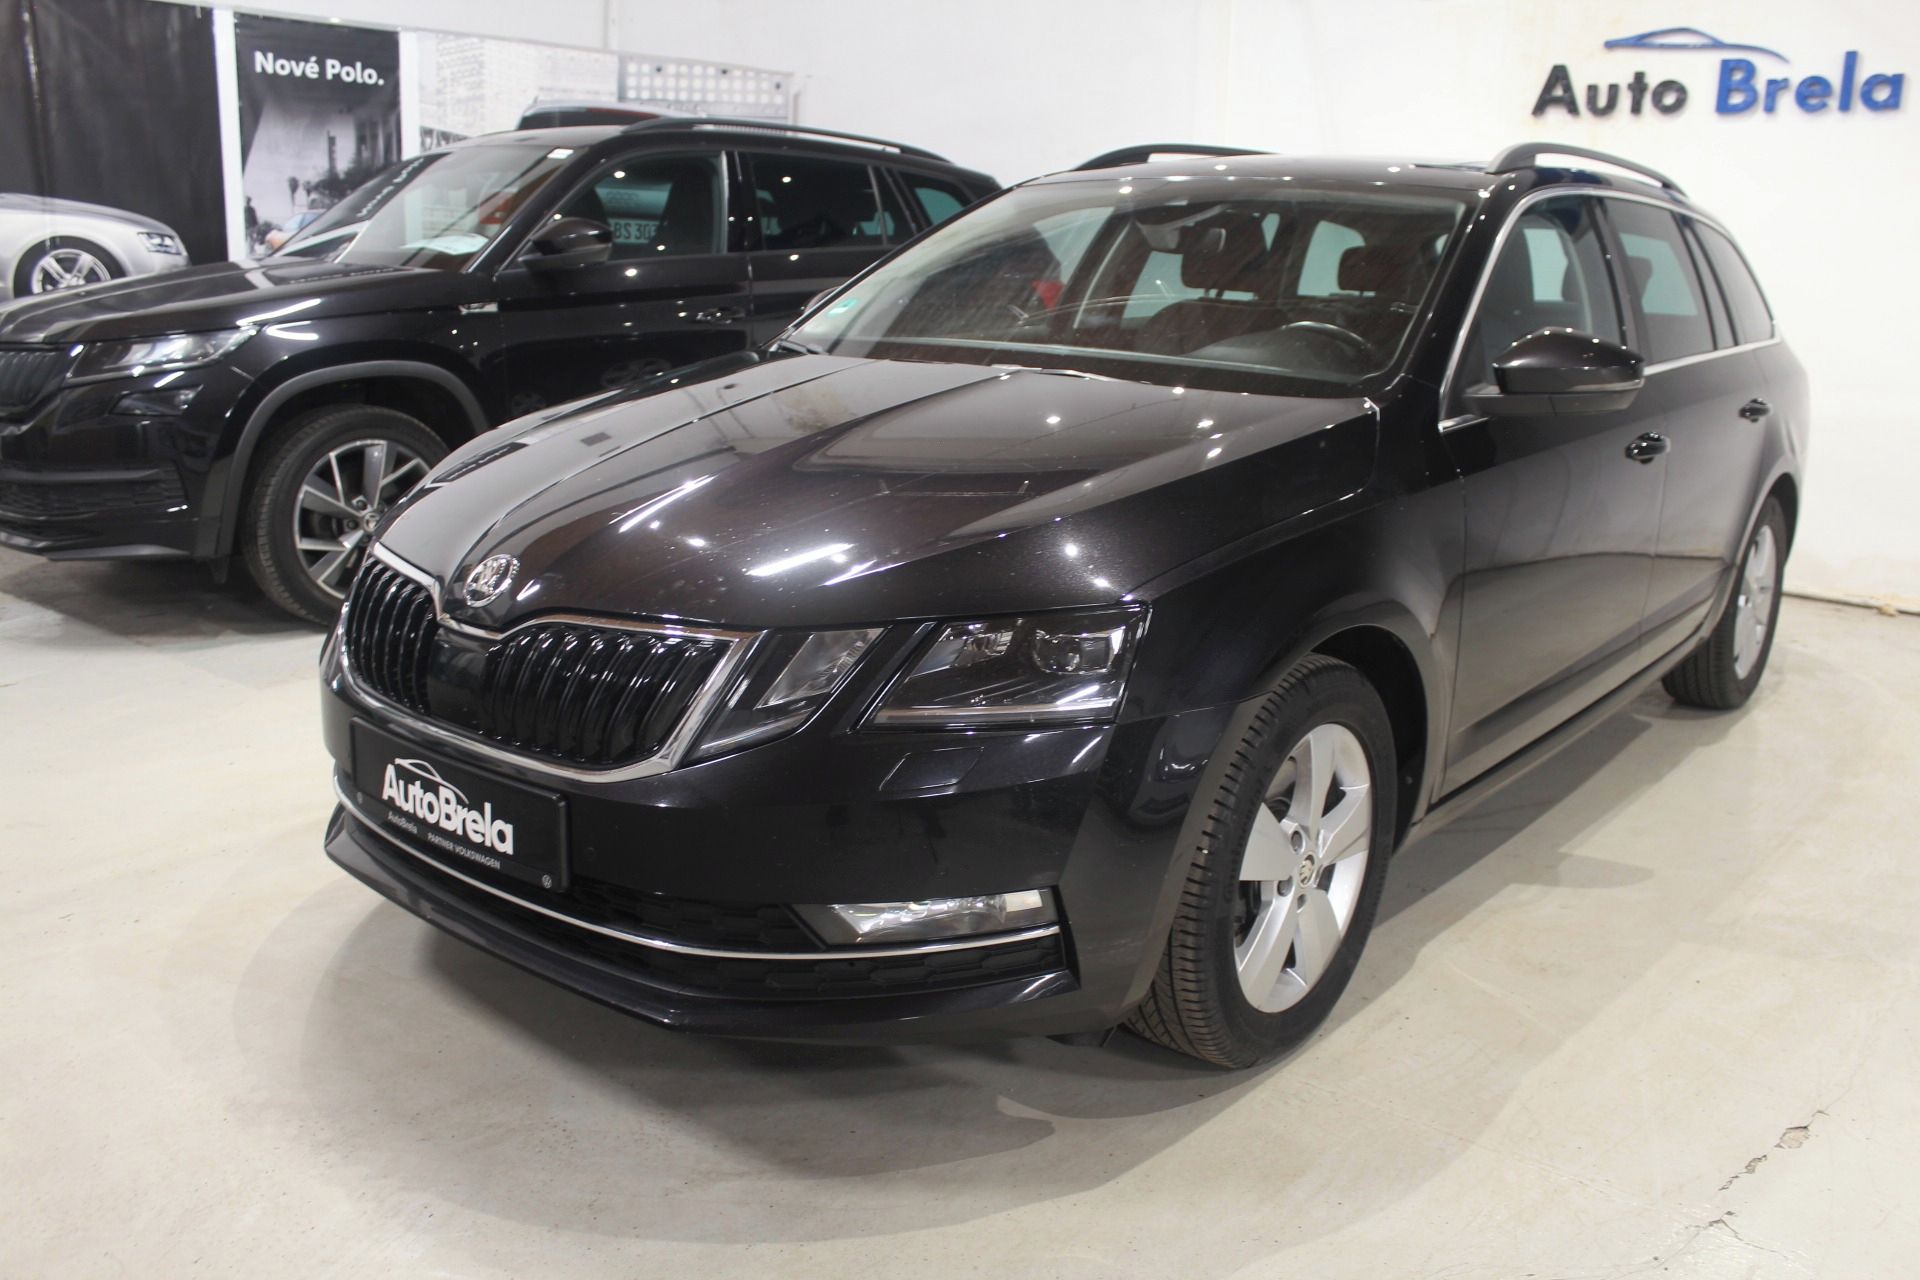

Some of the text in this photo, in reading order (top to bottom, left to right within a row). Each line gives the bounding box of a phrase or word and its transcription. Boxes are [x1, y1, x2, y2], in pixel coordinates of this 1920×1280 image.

[254, 50, 385, 86] Nové Polo.
[1531, 50, 1905, 117] Auto Brela
[381, 763, 514, 855] AutoBrela
[455, 843, 501, 870] VOLKSWAGEN
